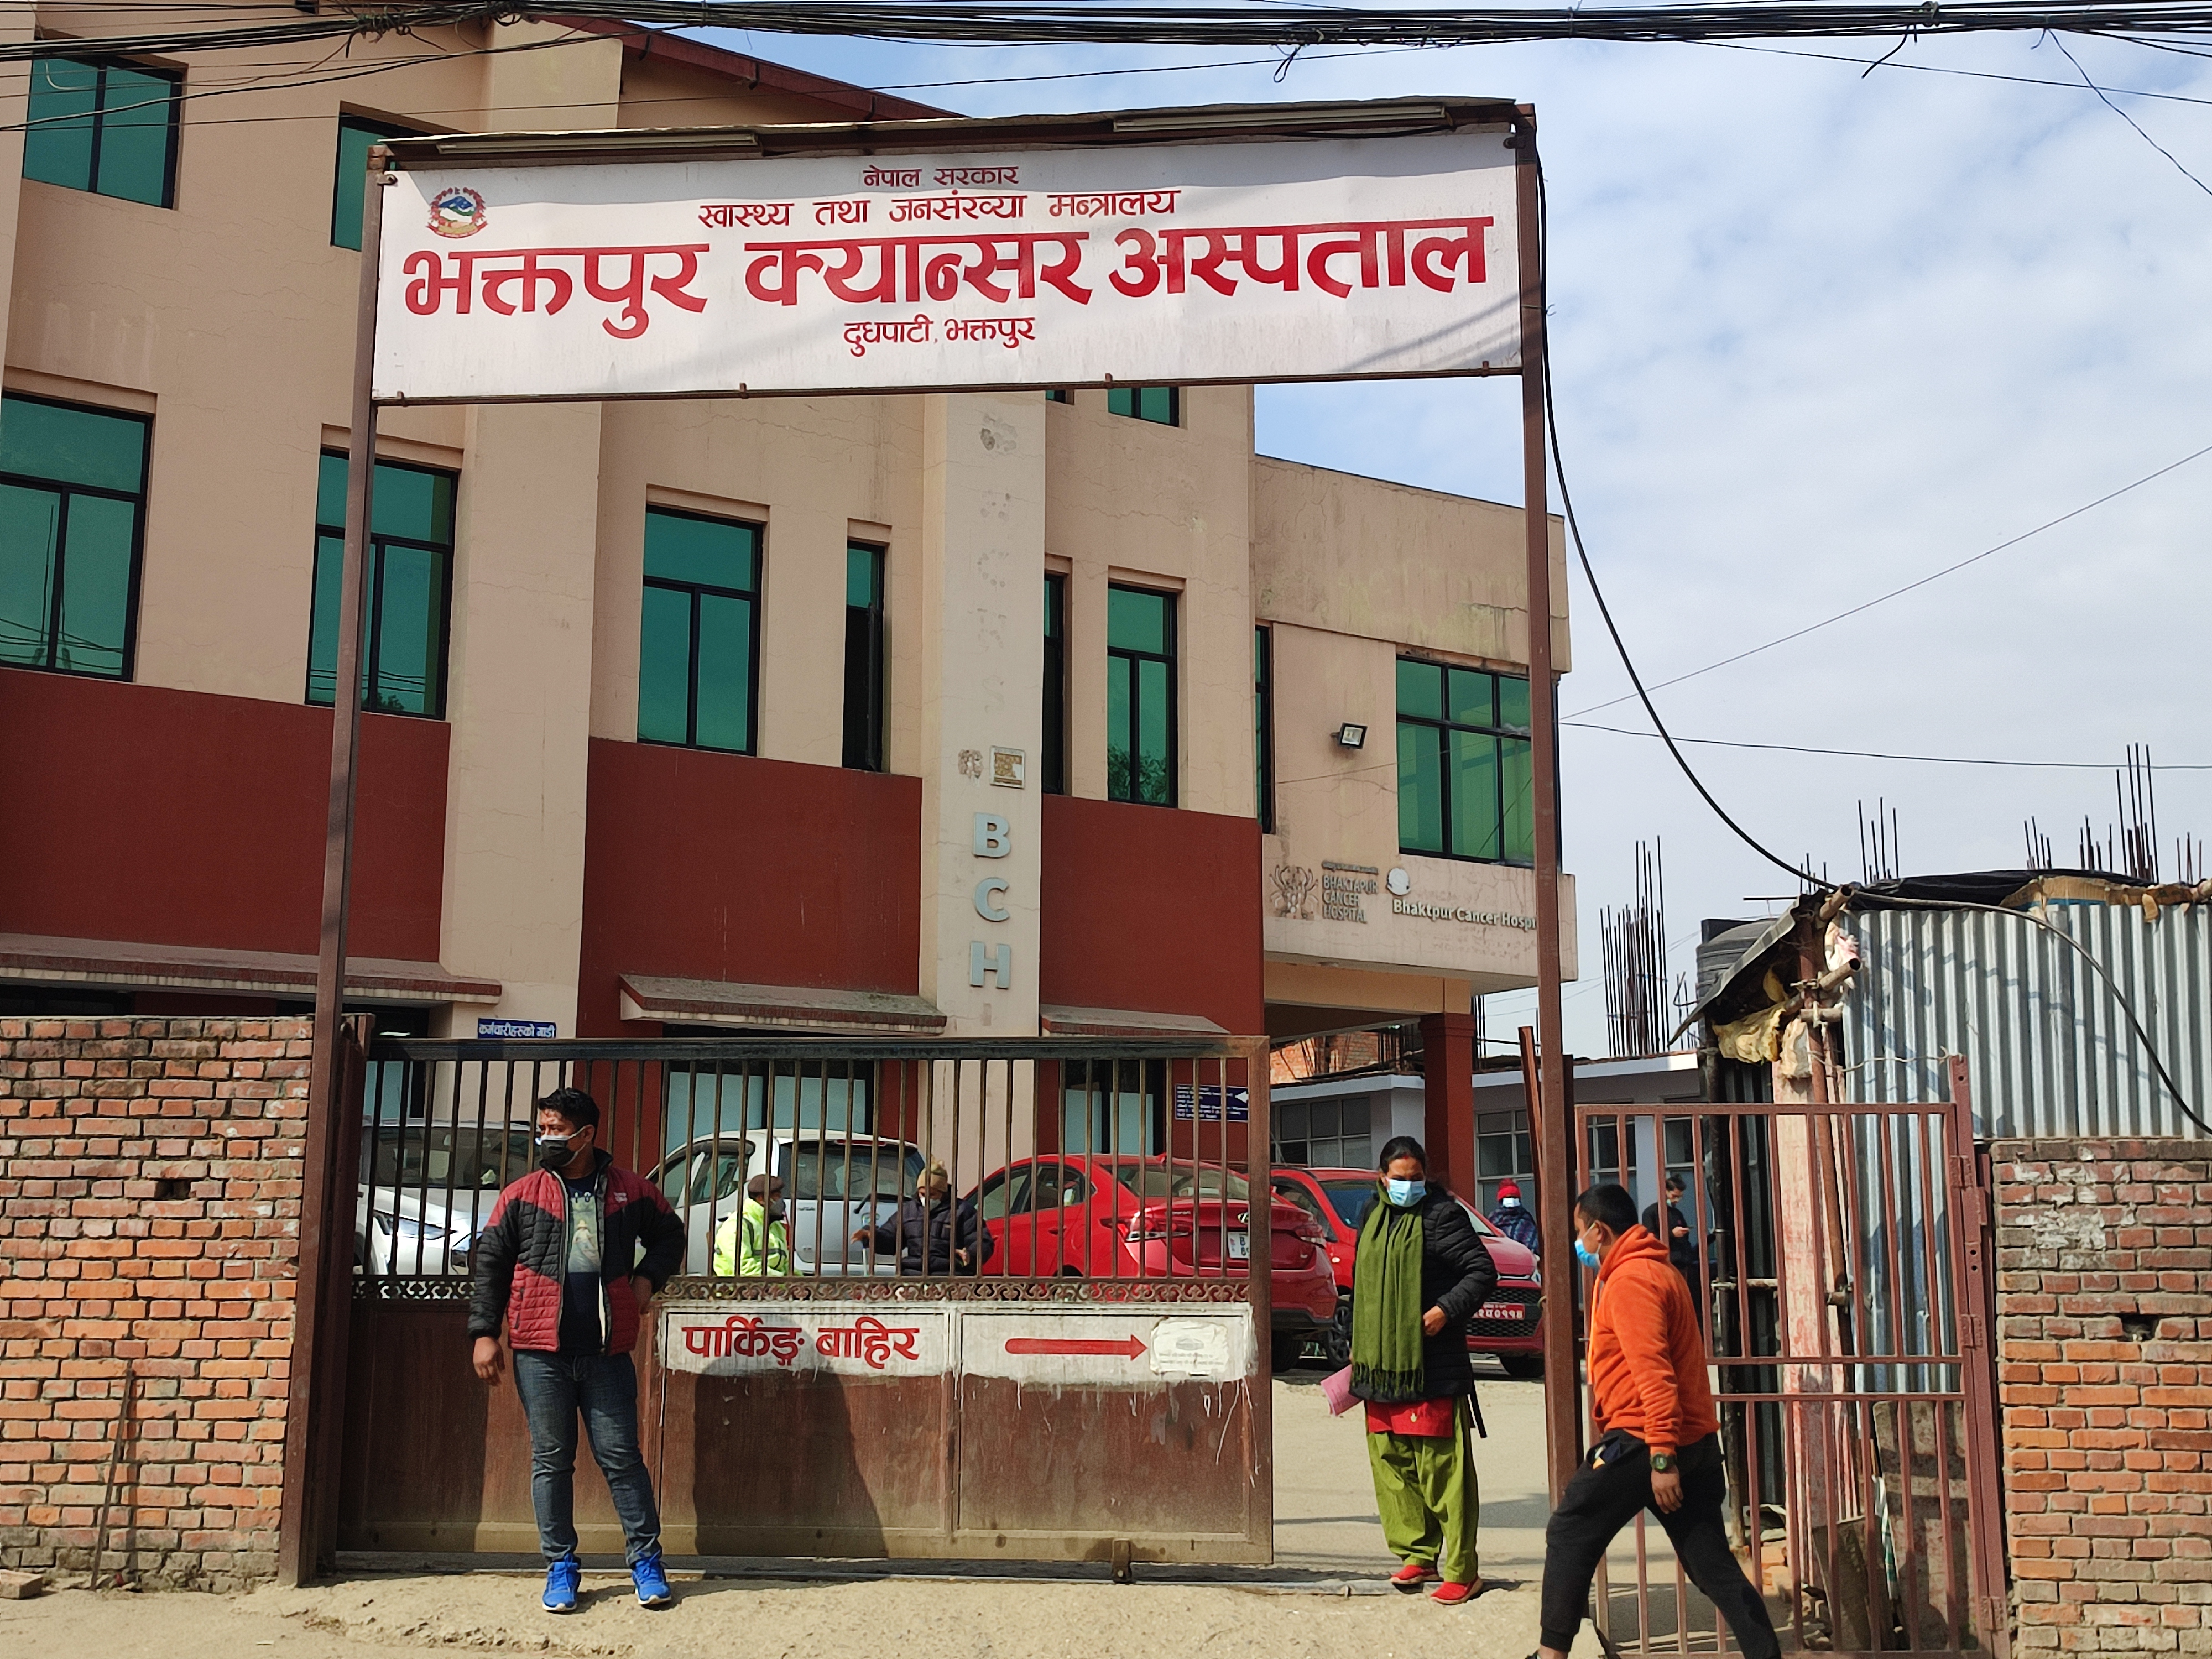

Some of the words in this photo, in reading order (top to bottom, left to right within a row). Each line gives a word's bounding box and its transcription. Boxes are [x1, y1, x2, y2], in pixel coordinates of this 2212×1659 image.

[863, 165, 922, 187] नेपाल
[933, 166, 1020, 186] सरकार
[697, 202, 795, 228] स्वास्थ्य
[812, 200, 872, 226] तथा
[888, 189, 1029, 222] जनसंख्या
[1048, 190, 1182, 218] मन्त्रालय
[402, 242, 711, 341] भक्तपुर
[743, 231, 1093, 307] क्यान्सर
[1103, 212, 1495, 299] अस्पताल
[943, 316, 1036, 349] भक्तपुर
[1322, 875, 1378, 894] BHAKTAPUR
[1322, 890, 1360, 907] CANCER
[1322, 905, 1368, 924] HOSPITAL
[1456, 907, 1500, 926] Cancer
[1501, 911, 1538, 932] Hospi
[816, 1316, 920, 1370] बाहिर
